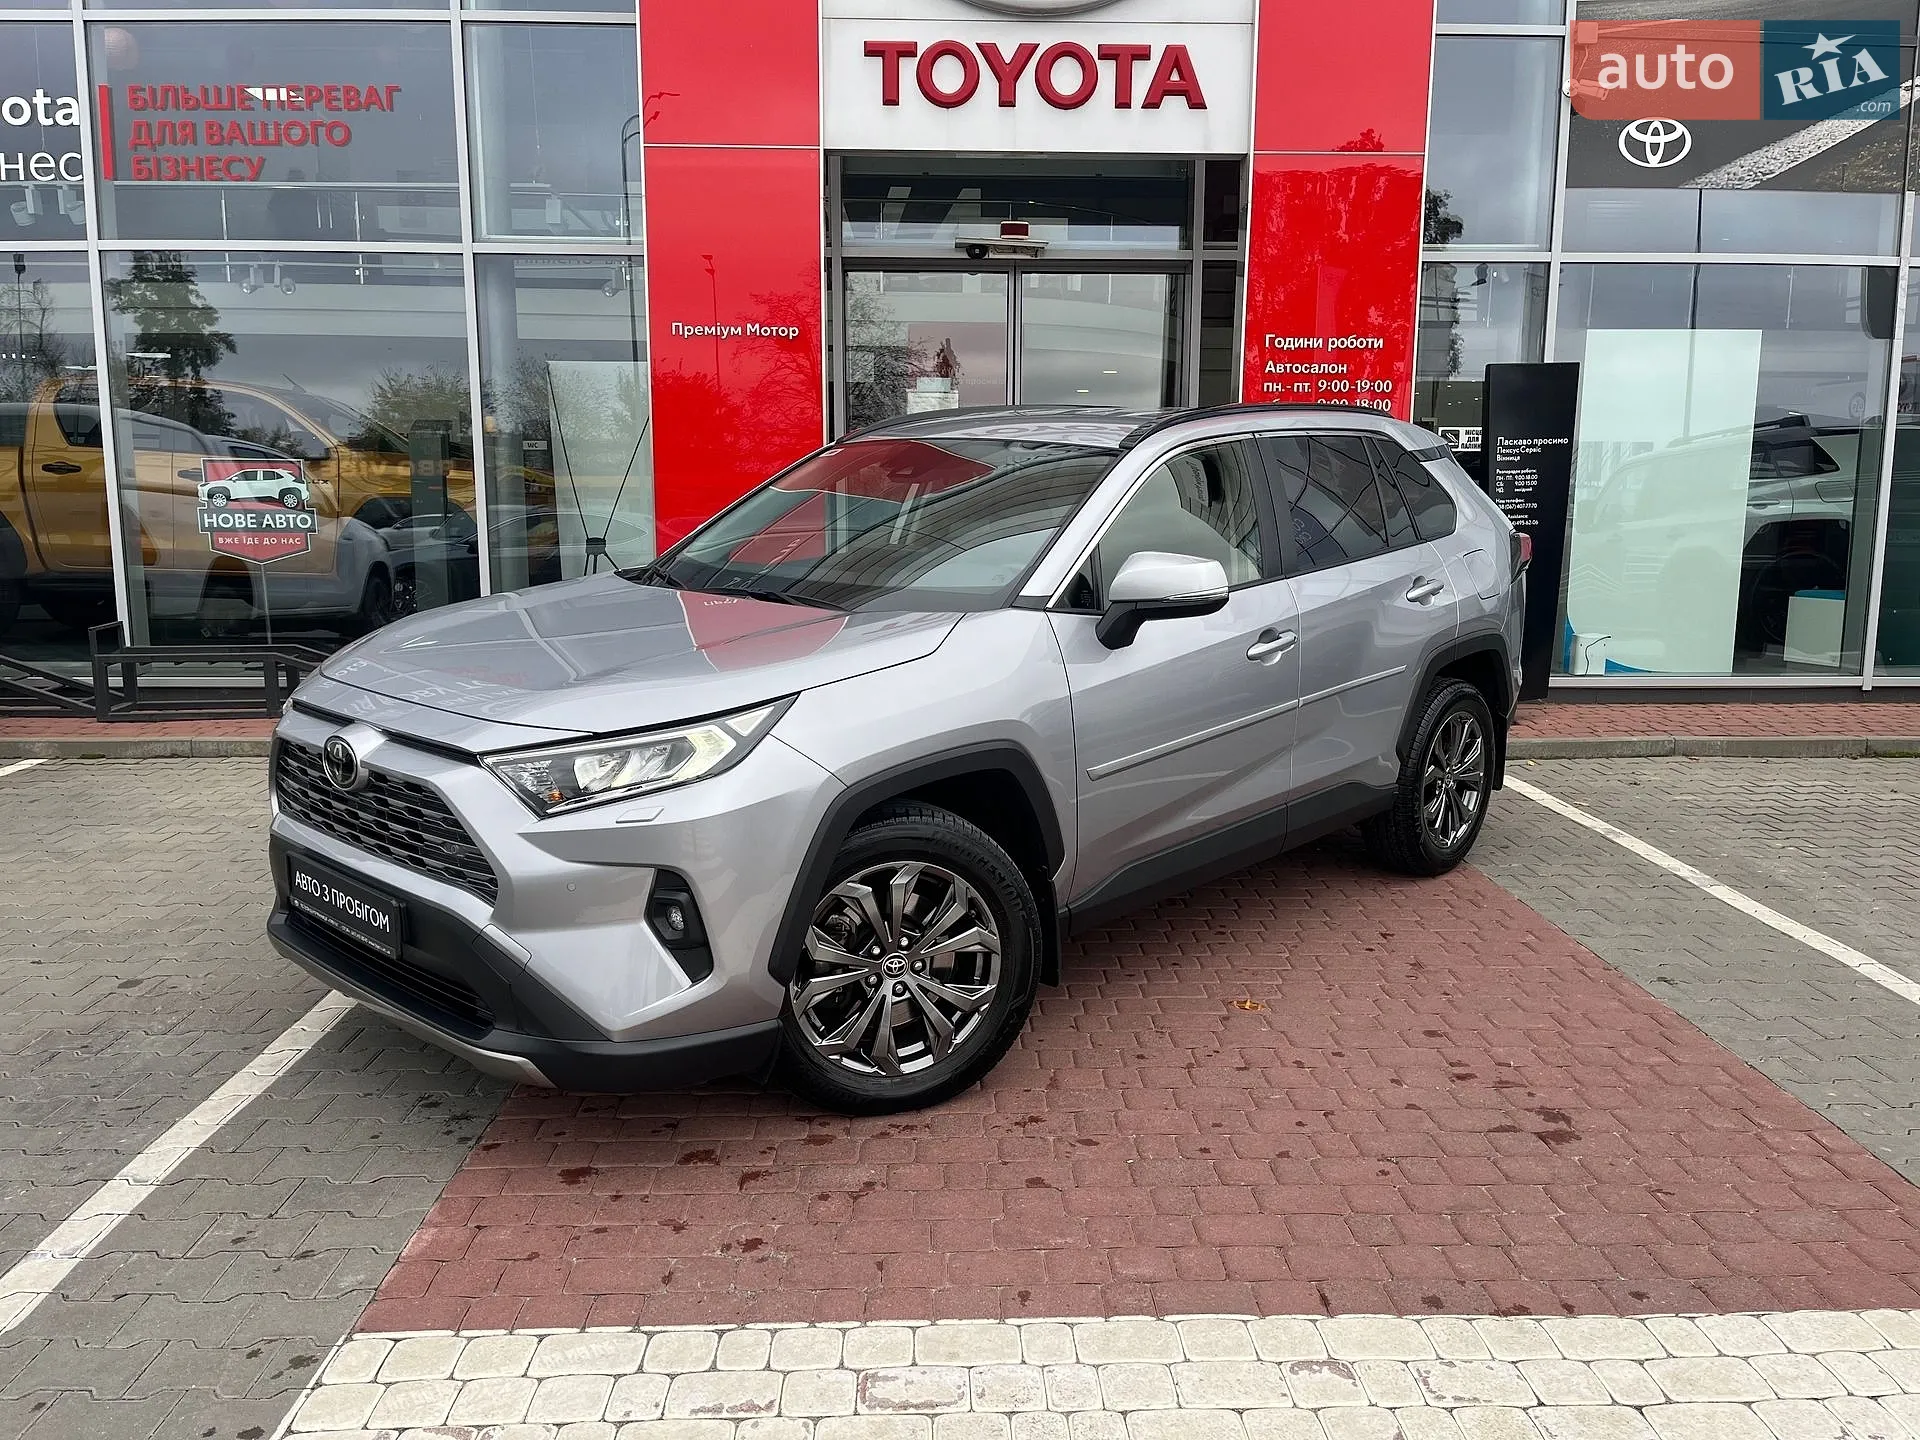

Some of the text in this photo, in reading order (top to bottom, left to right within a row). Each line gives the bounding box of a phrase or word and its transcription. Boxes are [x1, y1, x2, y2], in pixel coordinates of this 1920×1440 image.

[863, 40, 1207, 110] TOYOTA
[127, 84, 401, 111] БІЛЬШЕ ПЕРЕВАГ
[1, 88, 81, 126] ota
[128, 119, 352, 151] ДЛЯ ВАШОГО
[131, 154, 265, 182] БІЗНЕСУ
[671, 322, 799, 339] Преміум Мотор
[1264, 334, 1384, 352] Години роботи
[1264, 360, 1348, 374] Автосалон
[1317, 379, 1393, 393] 9:00-19:00
[1496, 436, 1569, 447] Ласкаво просимо
[1496, 445, 1542, 454] Лексус Сервіс
[203, 513, 312, 529] НОВЕ АВТО
[243, 535, 260, 545] ЇДЕ
[263, 537, 277, 545] ДО
[281, 537, 301, 545] НАС
[295, 870, 320, 897] АВТО
[322, 884, 330, 902] З
[331, 888, 390, 933] ПРОБІГОМ
